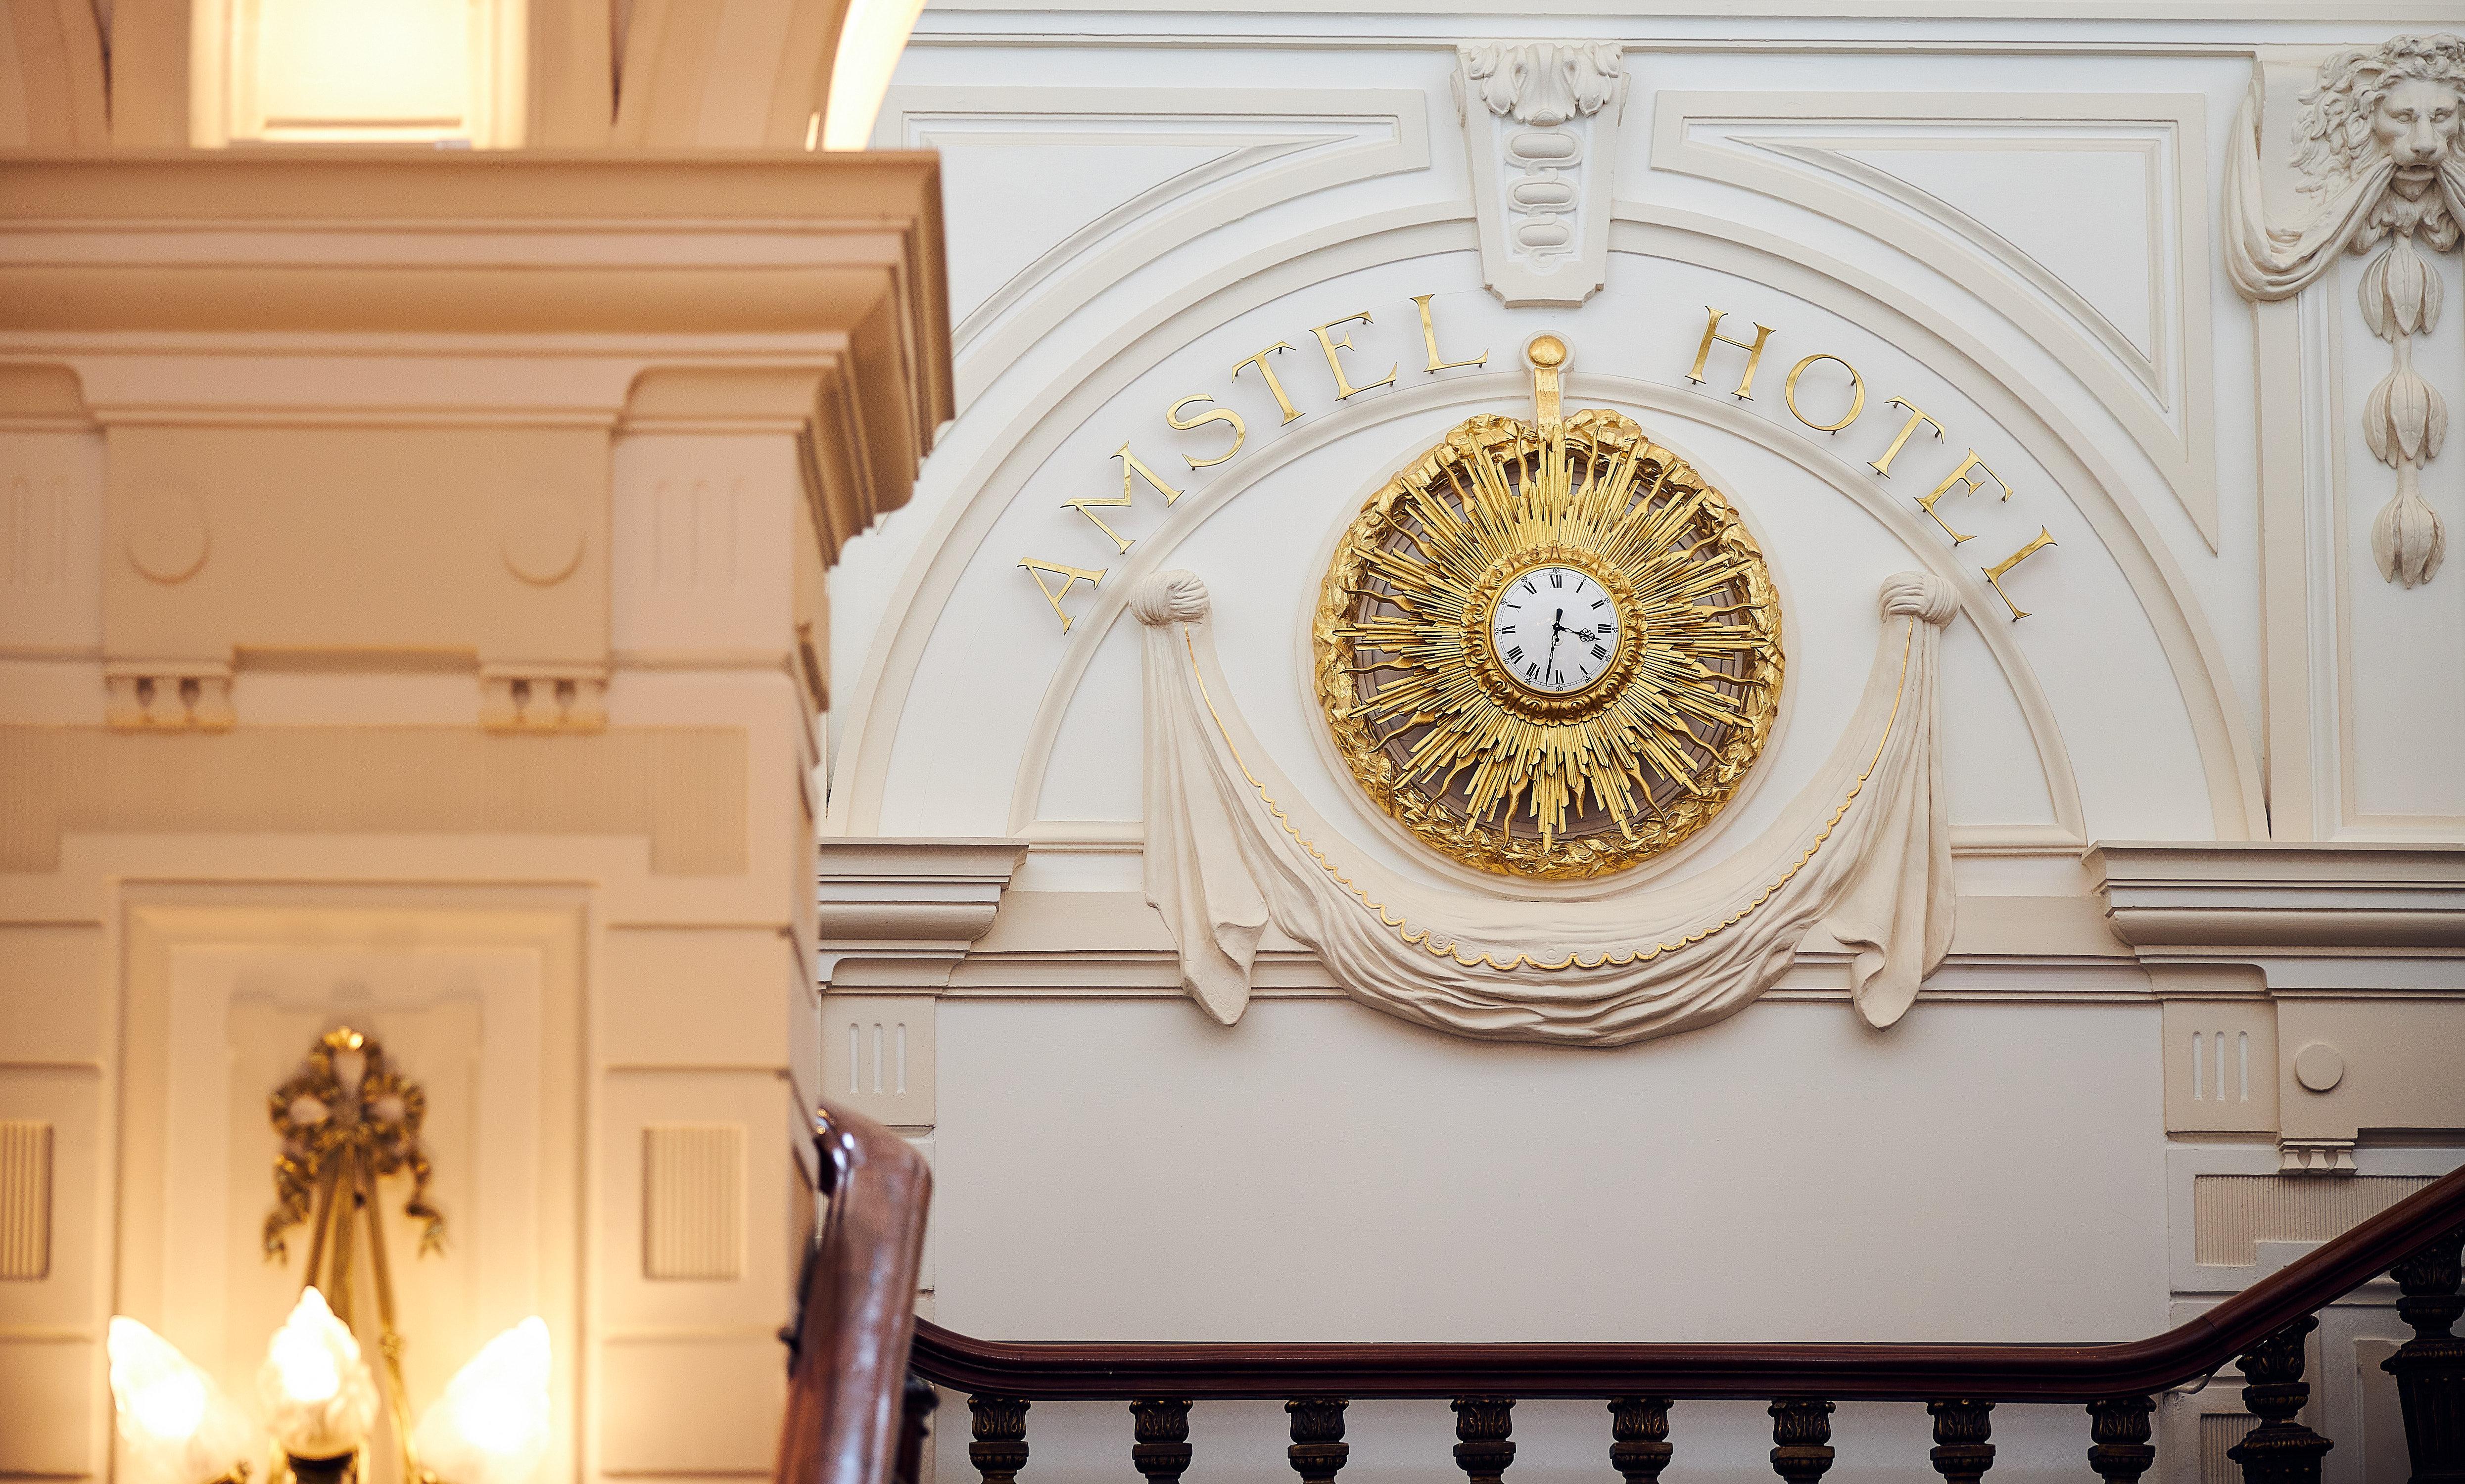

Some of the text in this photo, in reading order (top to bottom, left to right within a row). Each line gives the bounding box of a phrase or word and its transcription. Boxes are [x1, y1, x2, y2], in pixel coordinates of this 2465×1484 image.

[1017, 293, 2058, 636] AMSTEL HOTEL
[1548, 575, 1564, 589] XII
[1591, 600, 1605, 610] II
[1598, 624, 1611, 633] III
